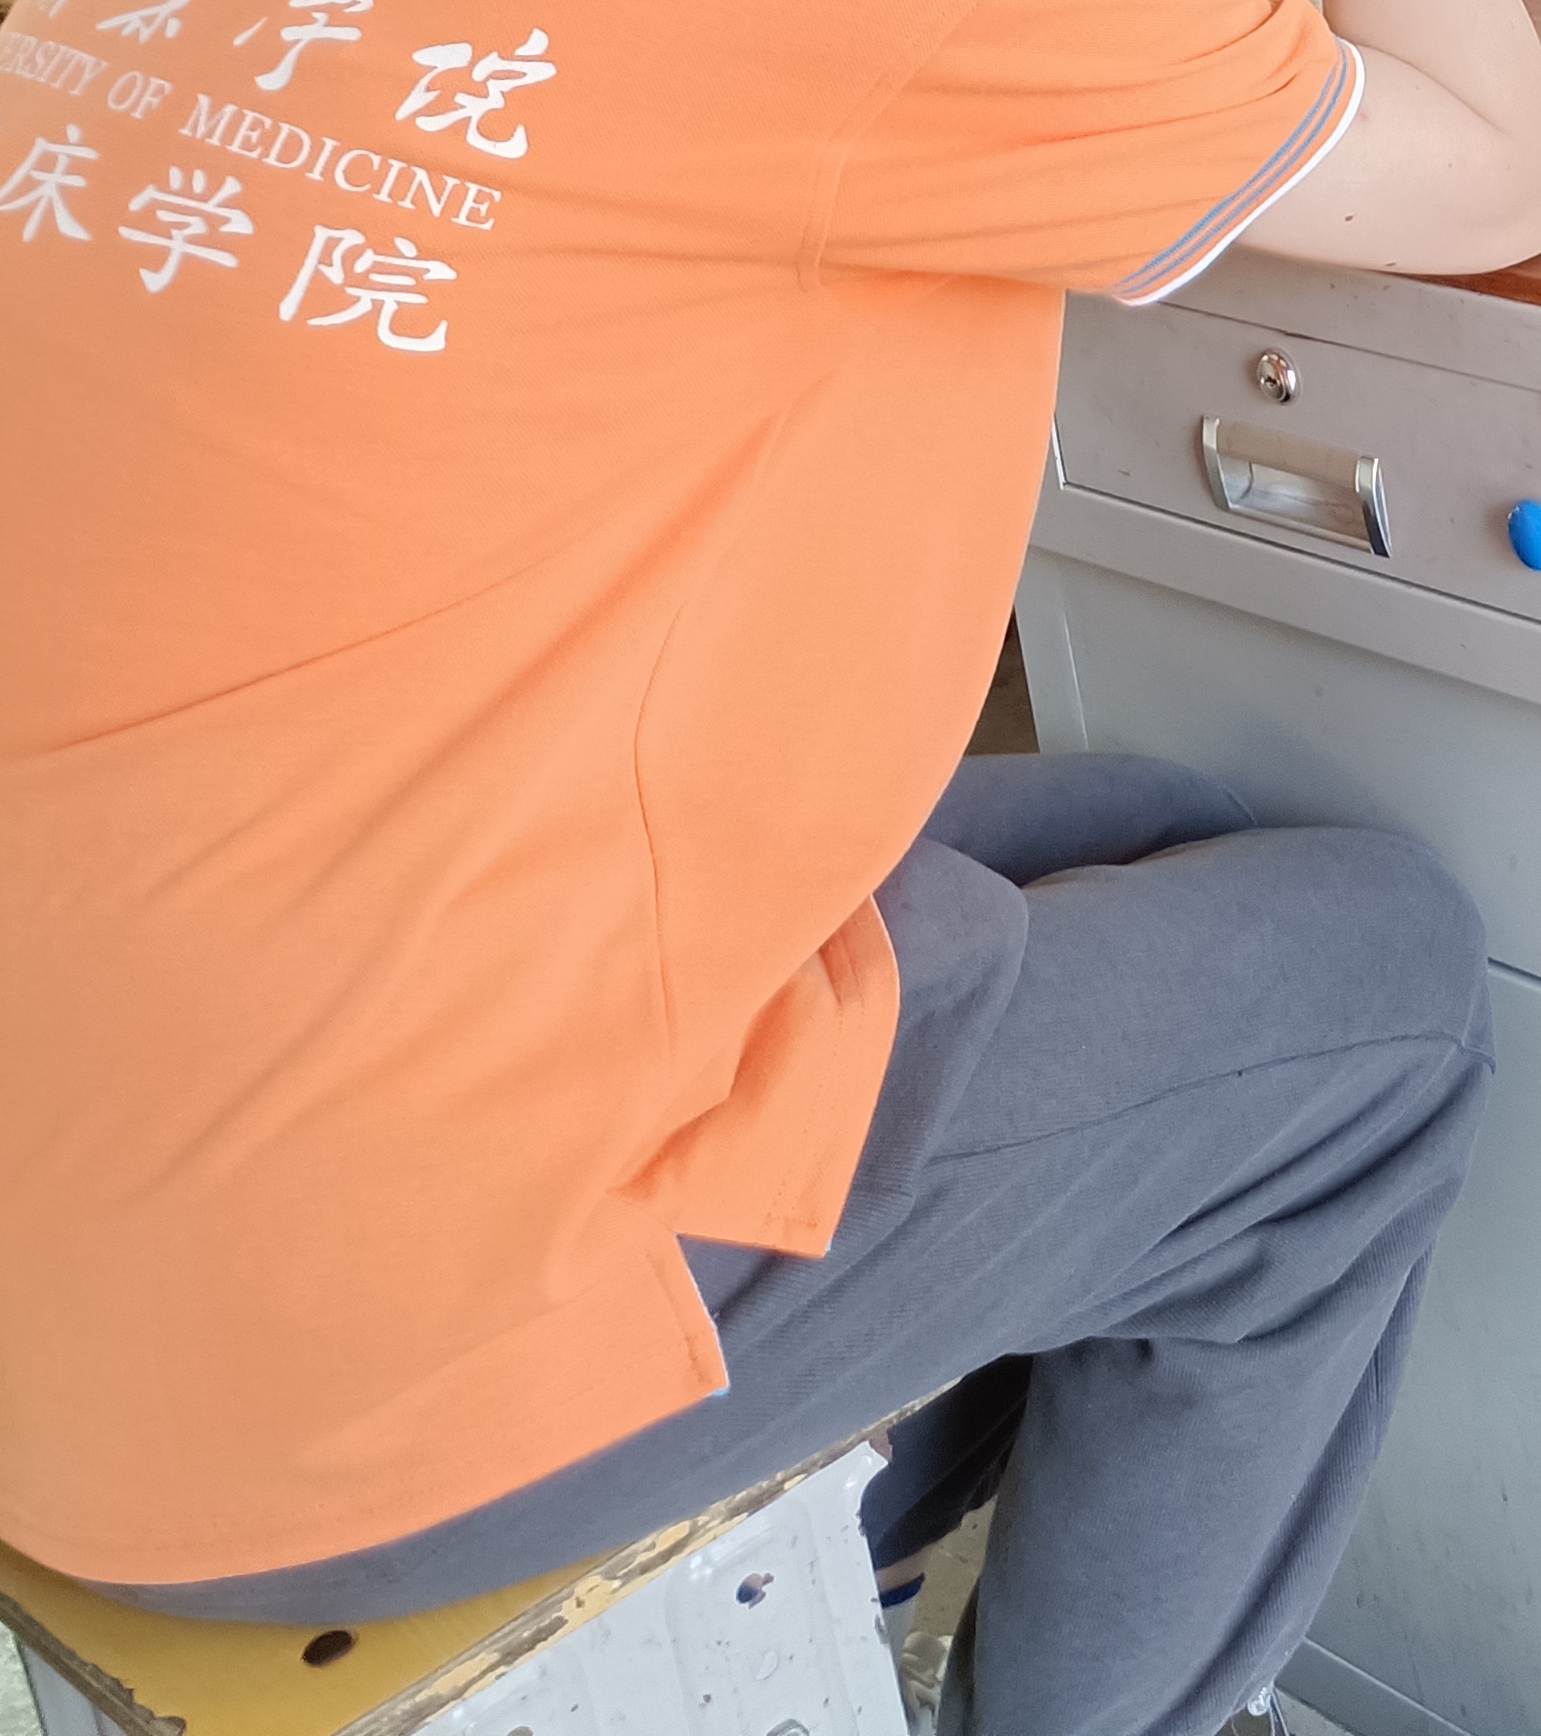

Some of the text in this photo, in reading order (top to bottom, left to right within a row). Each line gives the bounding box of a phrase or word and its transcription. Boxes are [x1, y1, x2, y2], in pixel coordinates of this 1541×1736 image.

[0, 124, 458, 352] 床学院
[107, 69, 173, 120] OF
[180, 93, 502, 230] MEDICINE
